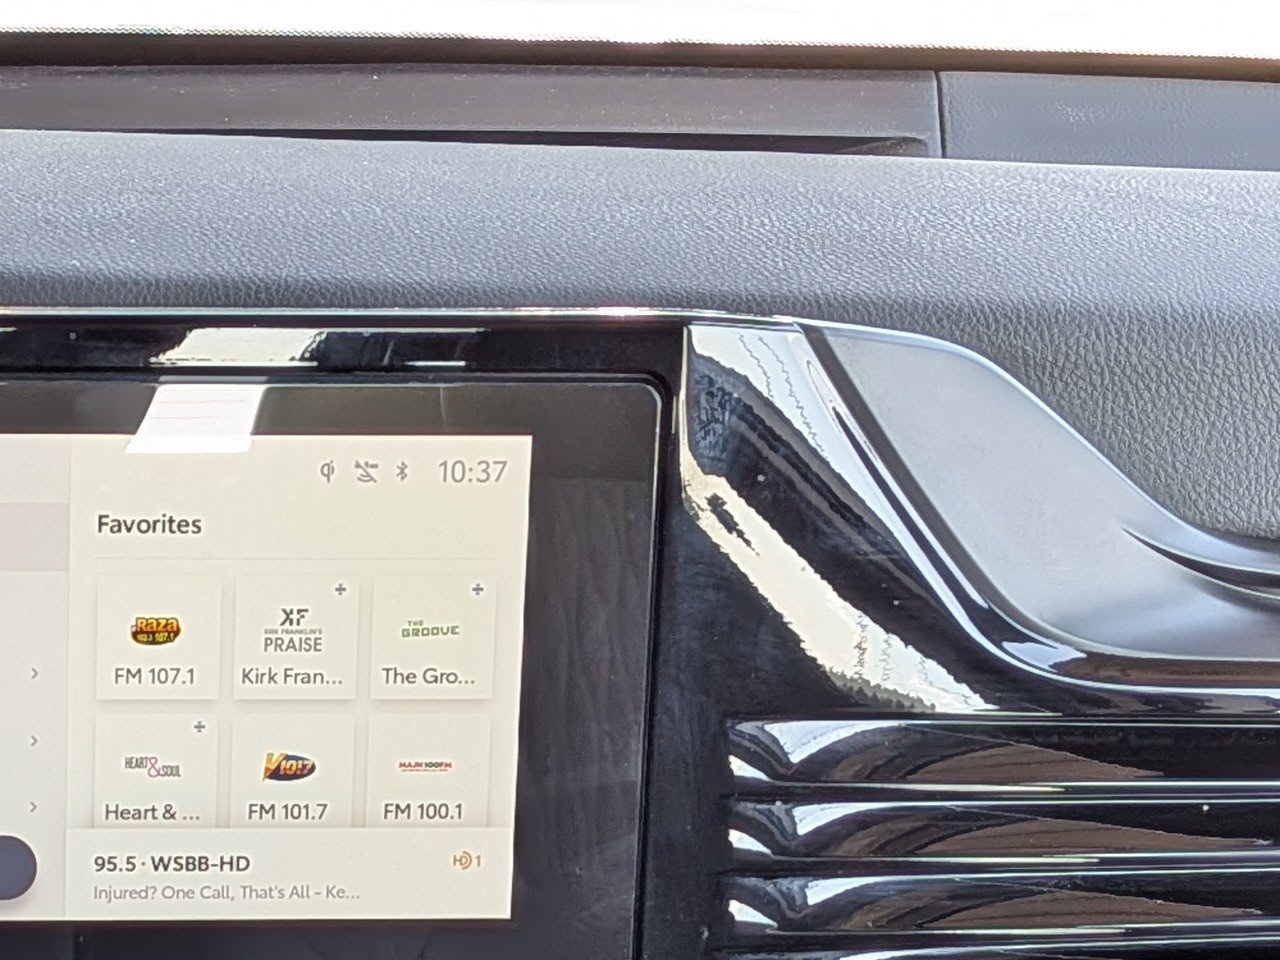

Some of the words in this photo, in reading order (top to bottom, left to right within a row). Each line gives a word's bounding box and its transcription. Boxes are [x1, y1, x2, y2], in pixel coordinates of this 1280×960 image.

[438, 460, 508, 483] 10:37
[97, 514, 202, 535] Favorites
[401, 626, 460, 638] GROOVE
[263, 637, 322, 652] PRAISE
[114, 667, 142, 684] FM
[148, 667, 194, 684] 107.1
[241, 667, 278, 684] Kirk
[283, 667, 343, 684] Fran...
[381, 667, 417, 684] The
[422, 667, 475, 684] Gro...
[104, 803, 158, 821] Heart
[162, 804, 177, 821] &
[248, 803, 276, 820] FM
[282, 803, 328, 820] 101.7
[384, 803, 411, 820] FM
[417, 803, 463, 820] 100.1
[94, 856, 136, 873] 95.5
[151, 856, 250, 873] WSBB-HD
[475, 855, 481, 867] 1
[94, 886, 157, 903] Injured?
[161, 886, 195, 899] One
[200, 885, 235, 901] Call,
[240, 885, 285, 899] That's
[289, 885, 310, 899] All
